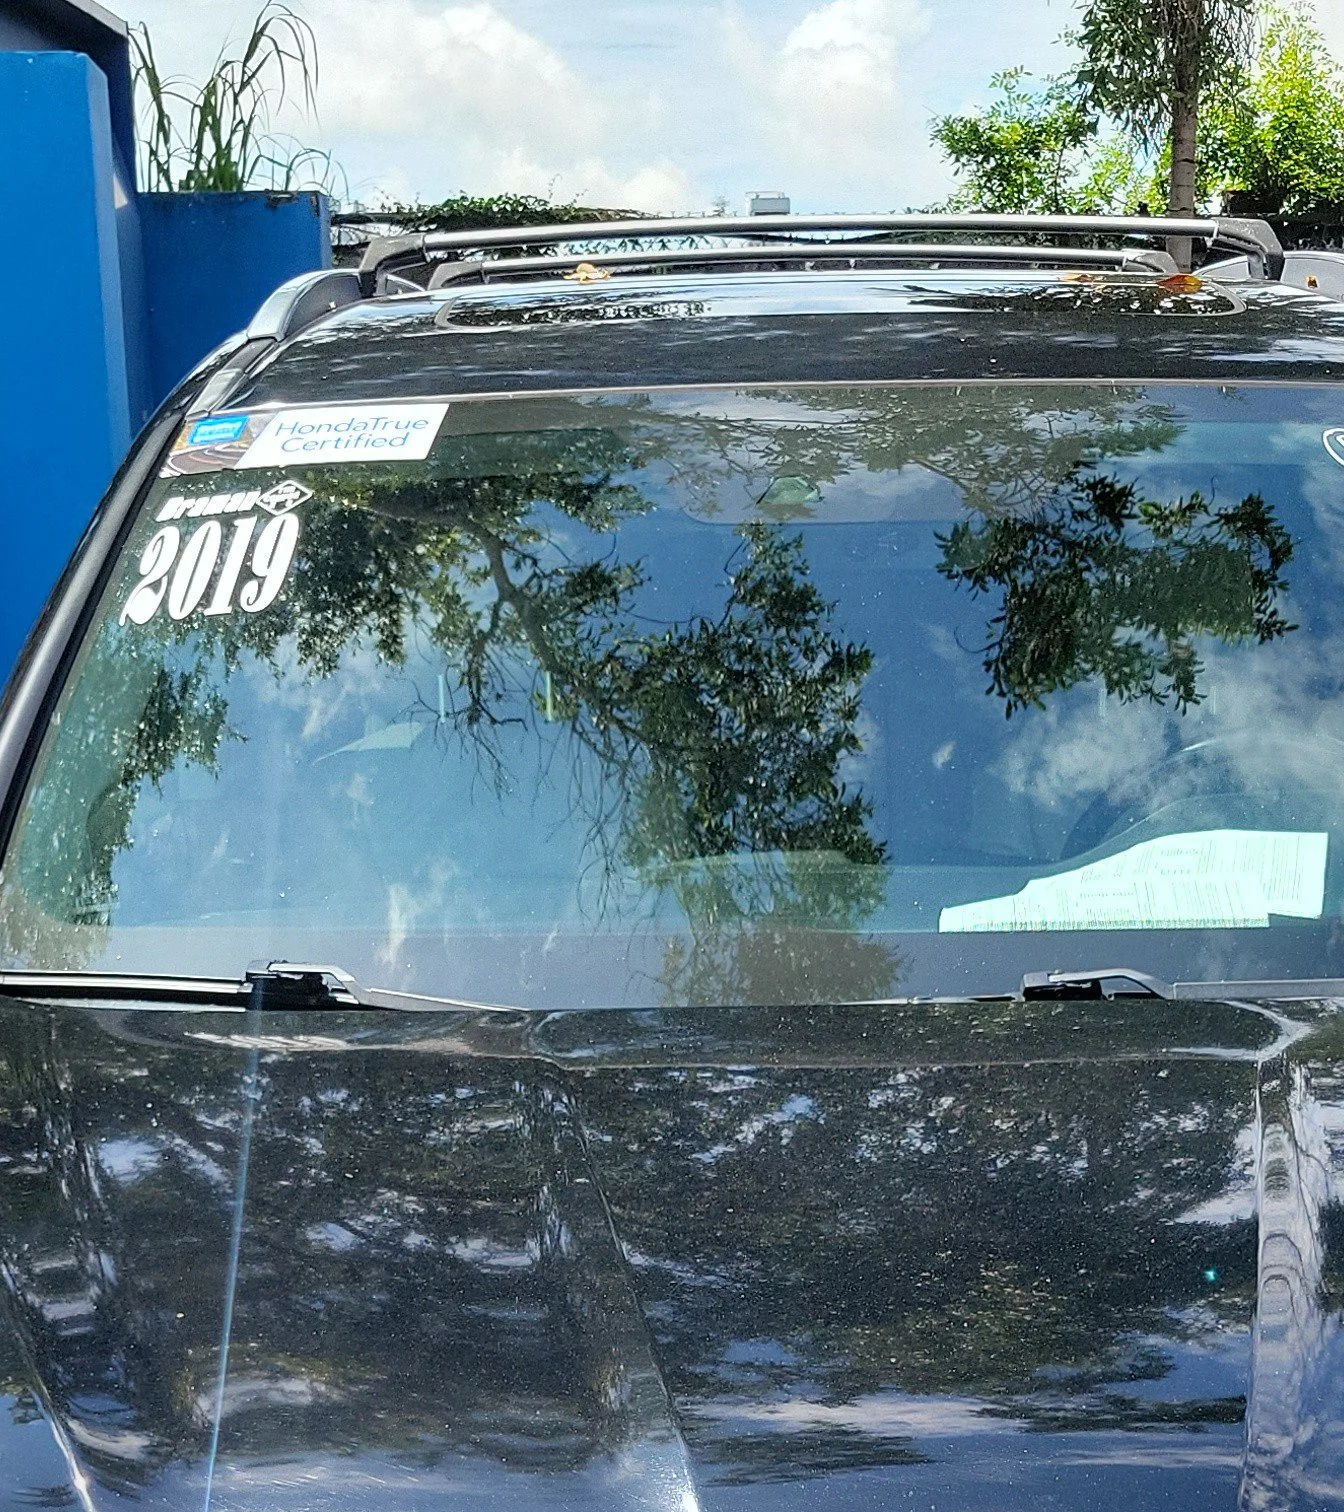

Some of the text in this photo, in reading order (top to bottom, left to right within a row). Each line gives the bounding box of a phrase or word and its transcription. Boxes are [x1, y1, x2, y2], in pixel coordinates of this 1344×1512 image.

[275, 416, 429, 437] HondaTrue
[281, 432, 410, 453] Certified
[119, 512, 300, 626] 2019
